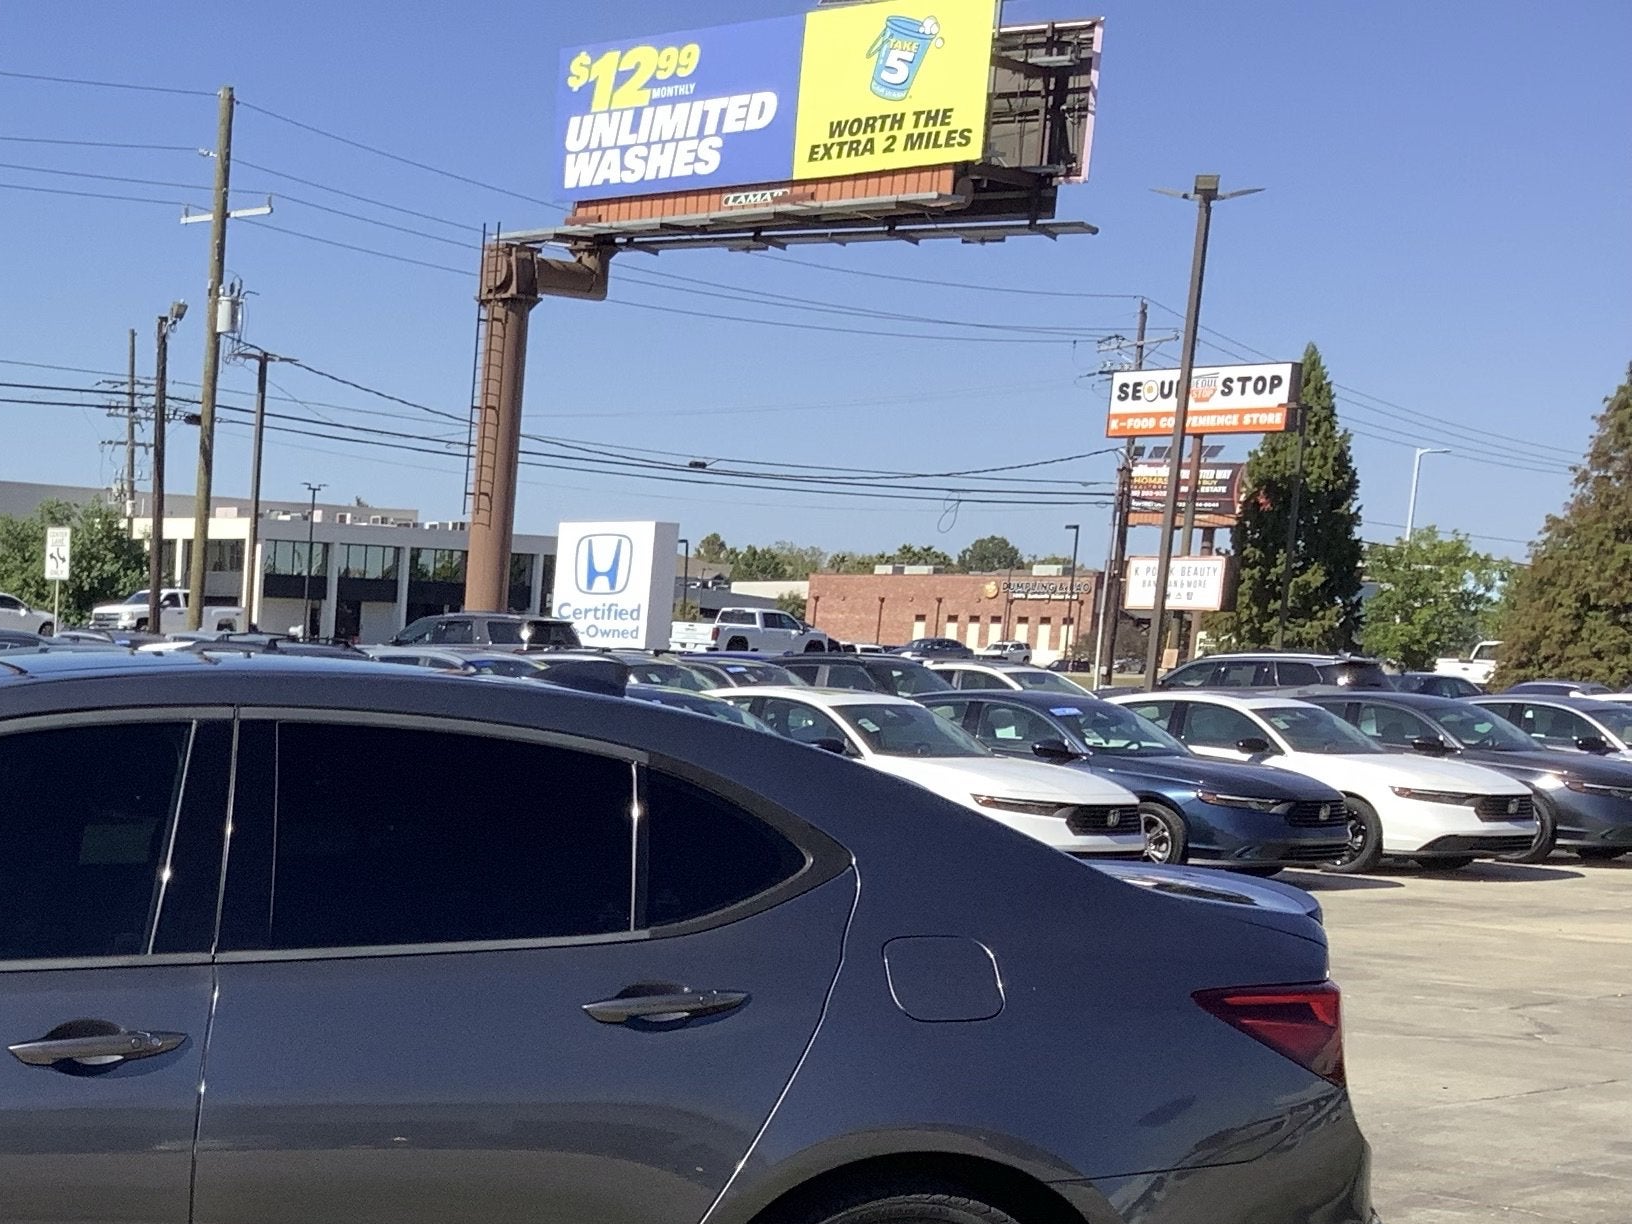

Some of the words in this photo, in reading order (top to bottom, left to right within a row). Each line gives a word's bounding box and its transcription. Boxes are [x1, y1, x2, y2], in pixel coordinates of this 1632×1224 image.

[889, 38, 919, 53] TAKE
[880, 49, 915, 85] 5
[652, 83, 695, 99] MONTHLY
[565, 92, 778, 152] UNLIMITED
[828, 112, 906, 139] WORTH
[912, 108, 954, 129] THE
[808, 138, 875, 163] EXTRA
[882, 134, 898, 154] 2
[903, 128, 973, 152] MILES
[564, 137, 723, 188] WASHES
[1220, 375, 1283, 396] STOP
[1159, 414, 1239, 429] COVENIENCE
[1243, 412, 1282, 425] STORE
[1181, 567, 1218, 577] BEAUTY
[1002, 582, 1057, 592] DUMPLING
[558, 602, 641, 621] Certified
